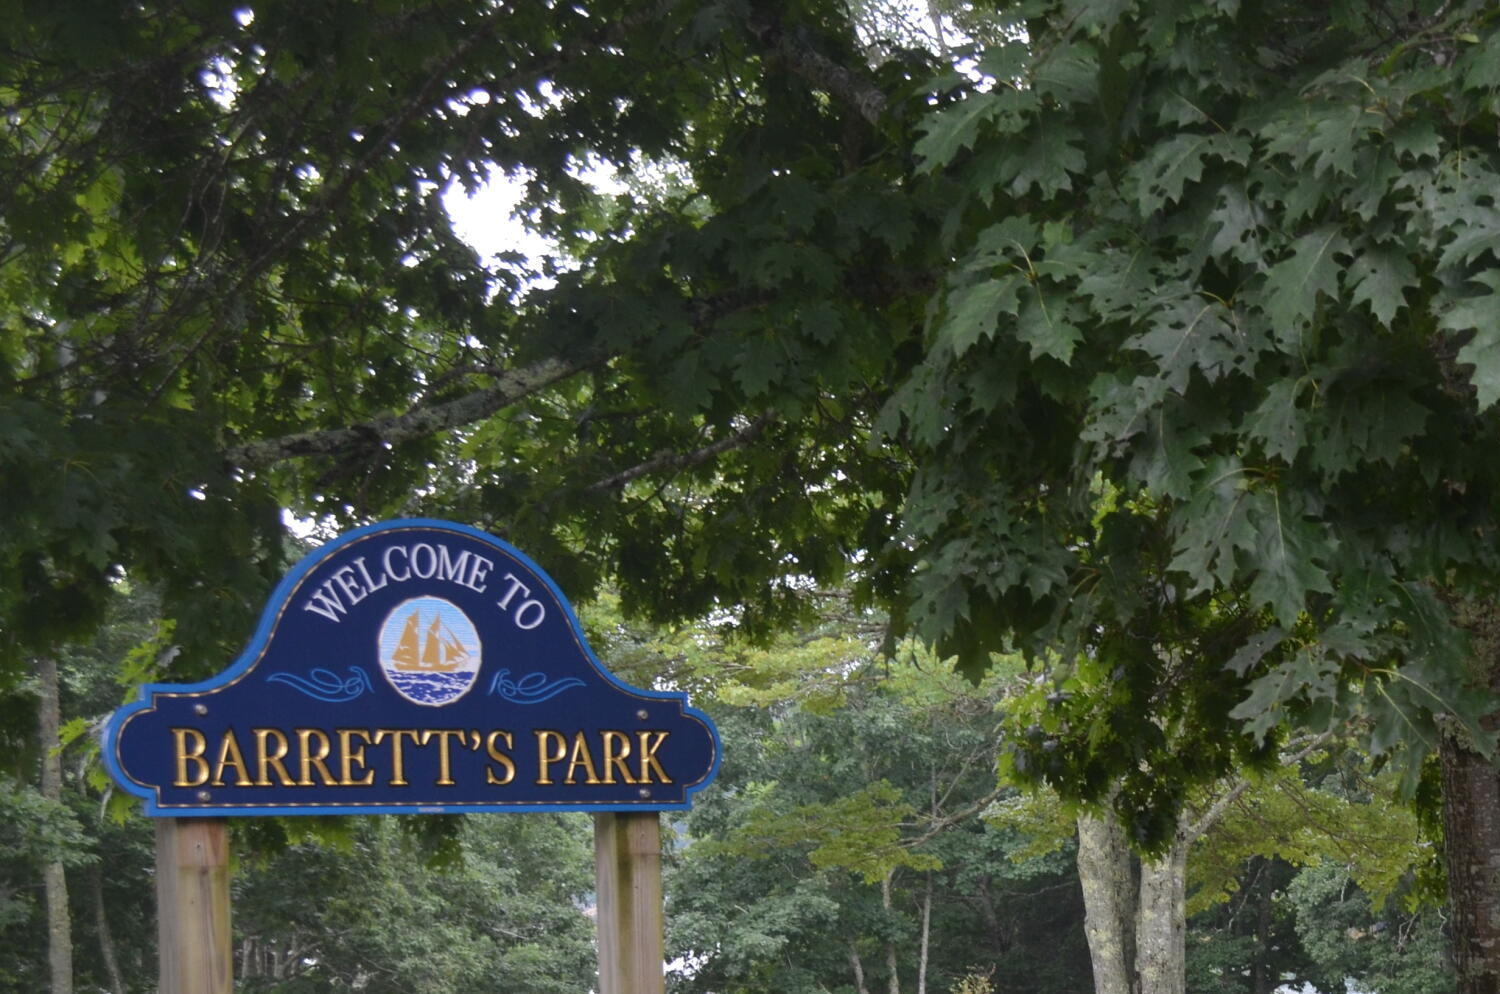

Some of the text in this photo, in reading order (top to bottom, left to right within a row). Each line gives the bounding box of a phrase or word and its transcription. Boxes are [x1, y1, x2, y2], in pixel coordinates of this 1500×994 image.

[305, 543, 546, 630] WELCOME TO
[171, 728, 672, 787] BARRETT'S PARK
